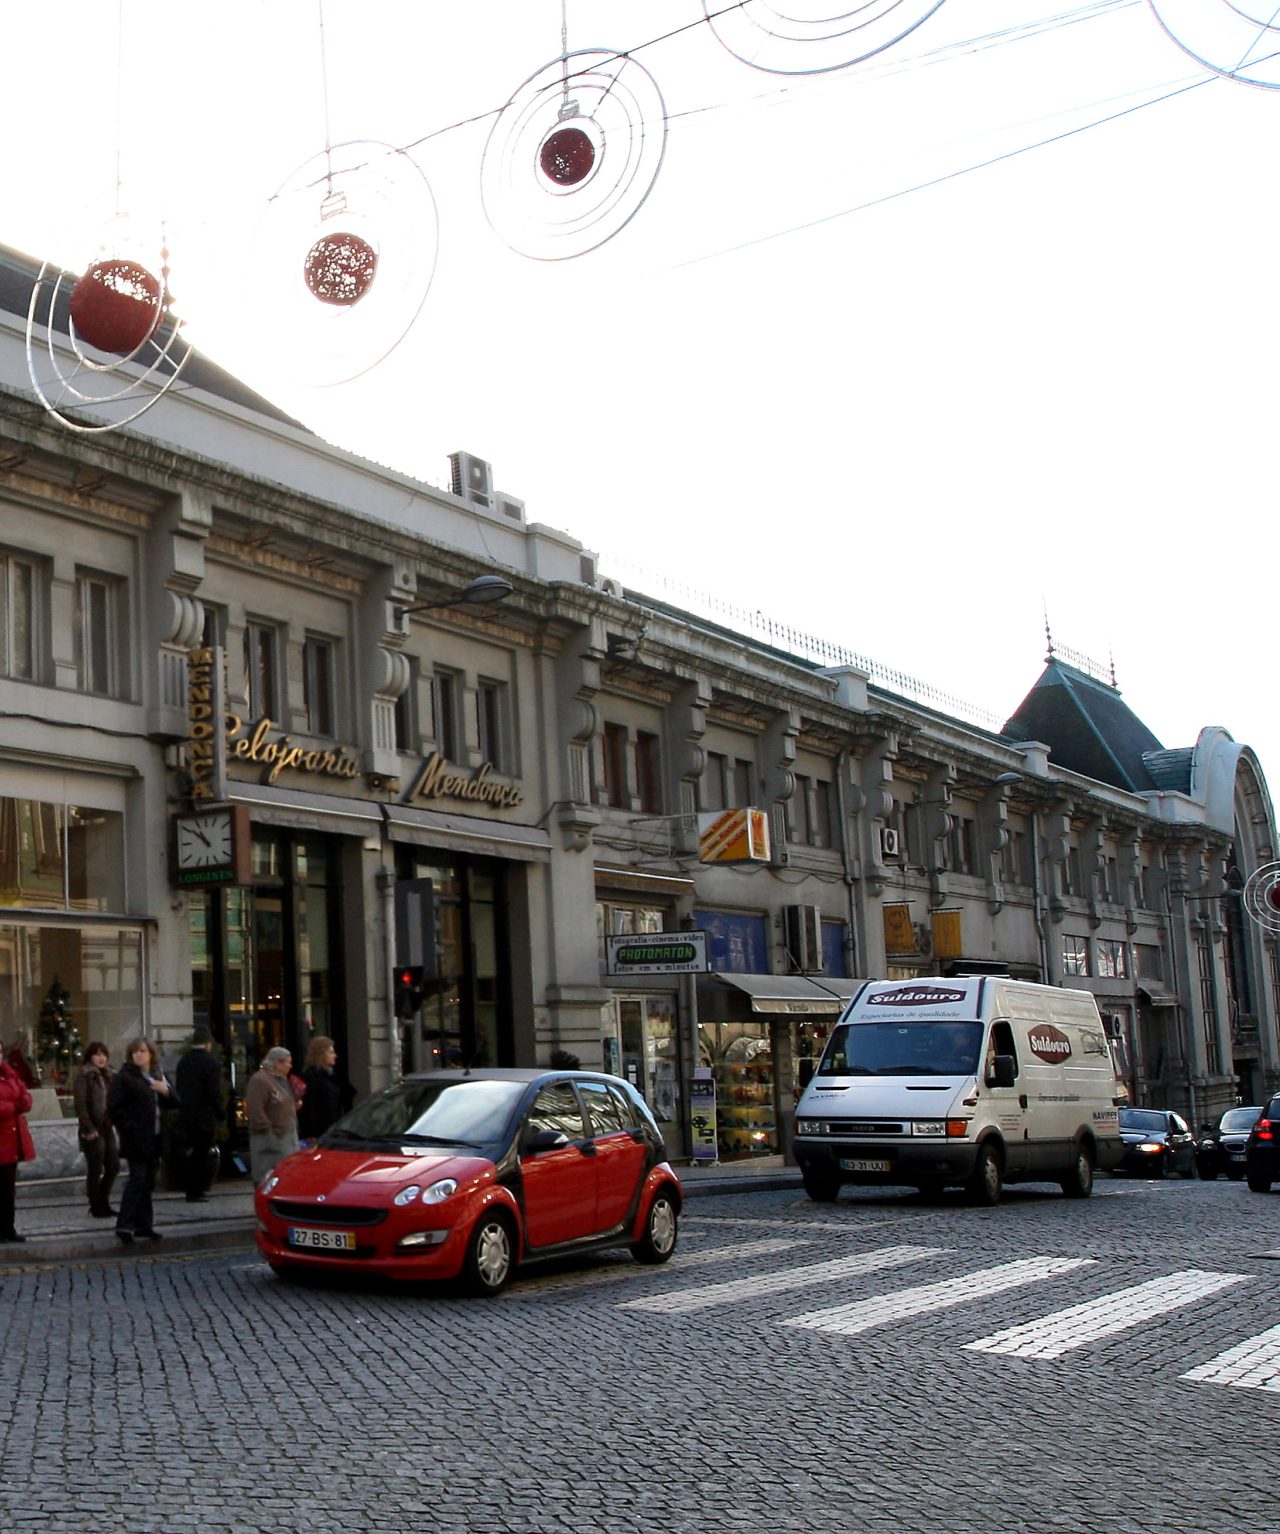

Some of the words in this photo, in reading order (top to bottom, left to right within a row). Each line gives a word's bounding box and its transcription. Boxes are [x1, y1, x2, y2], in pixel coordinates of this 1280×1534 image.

[410, 750, 524, 808] Mendonça
[620, 946, 692, 960] PHOTOMATON
[870, 991, 961, 1004] Suldouro
[1031, 1035, 1070, 1053] Suldouro
